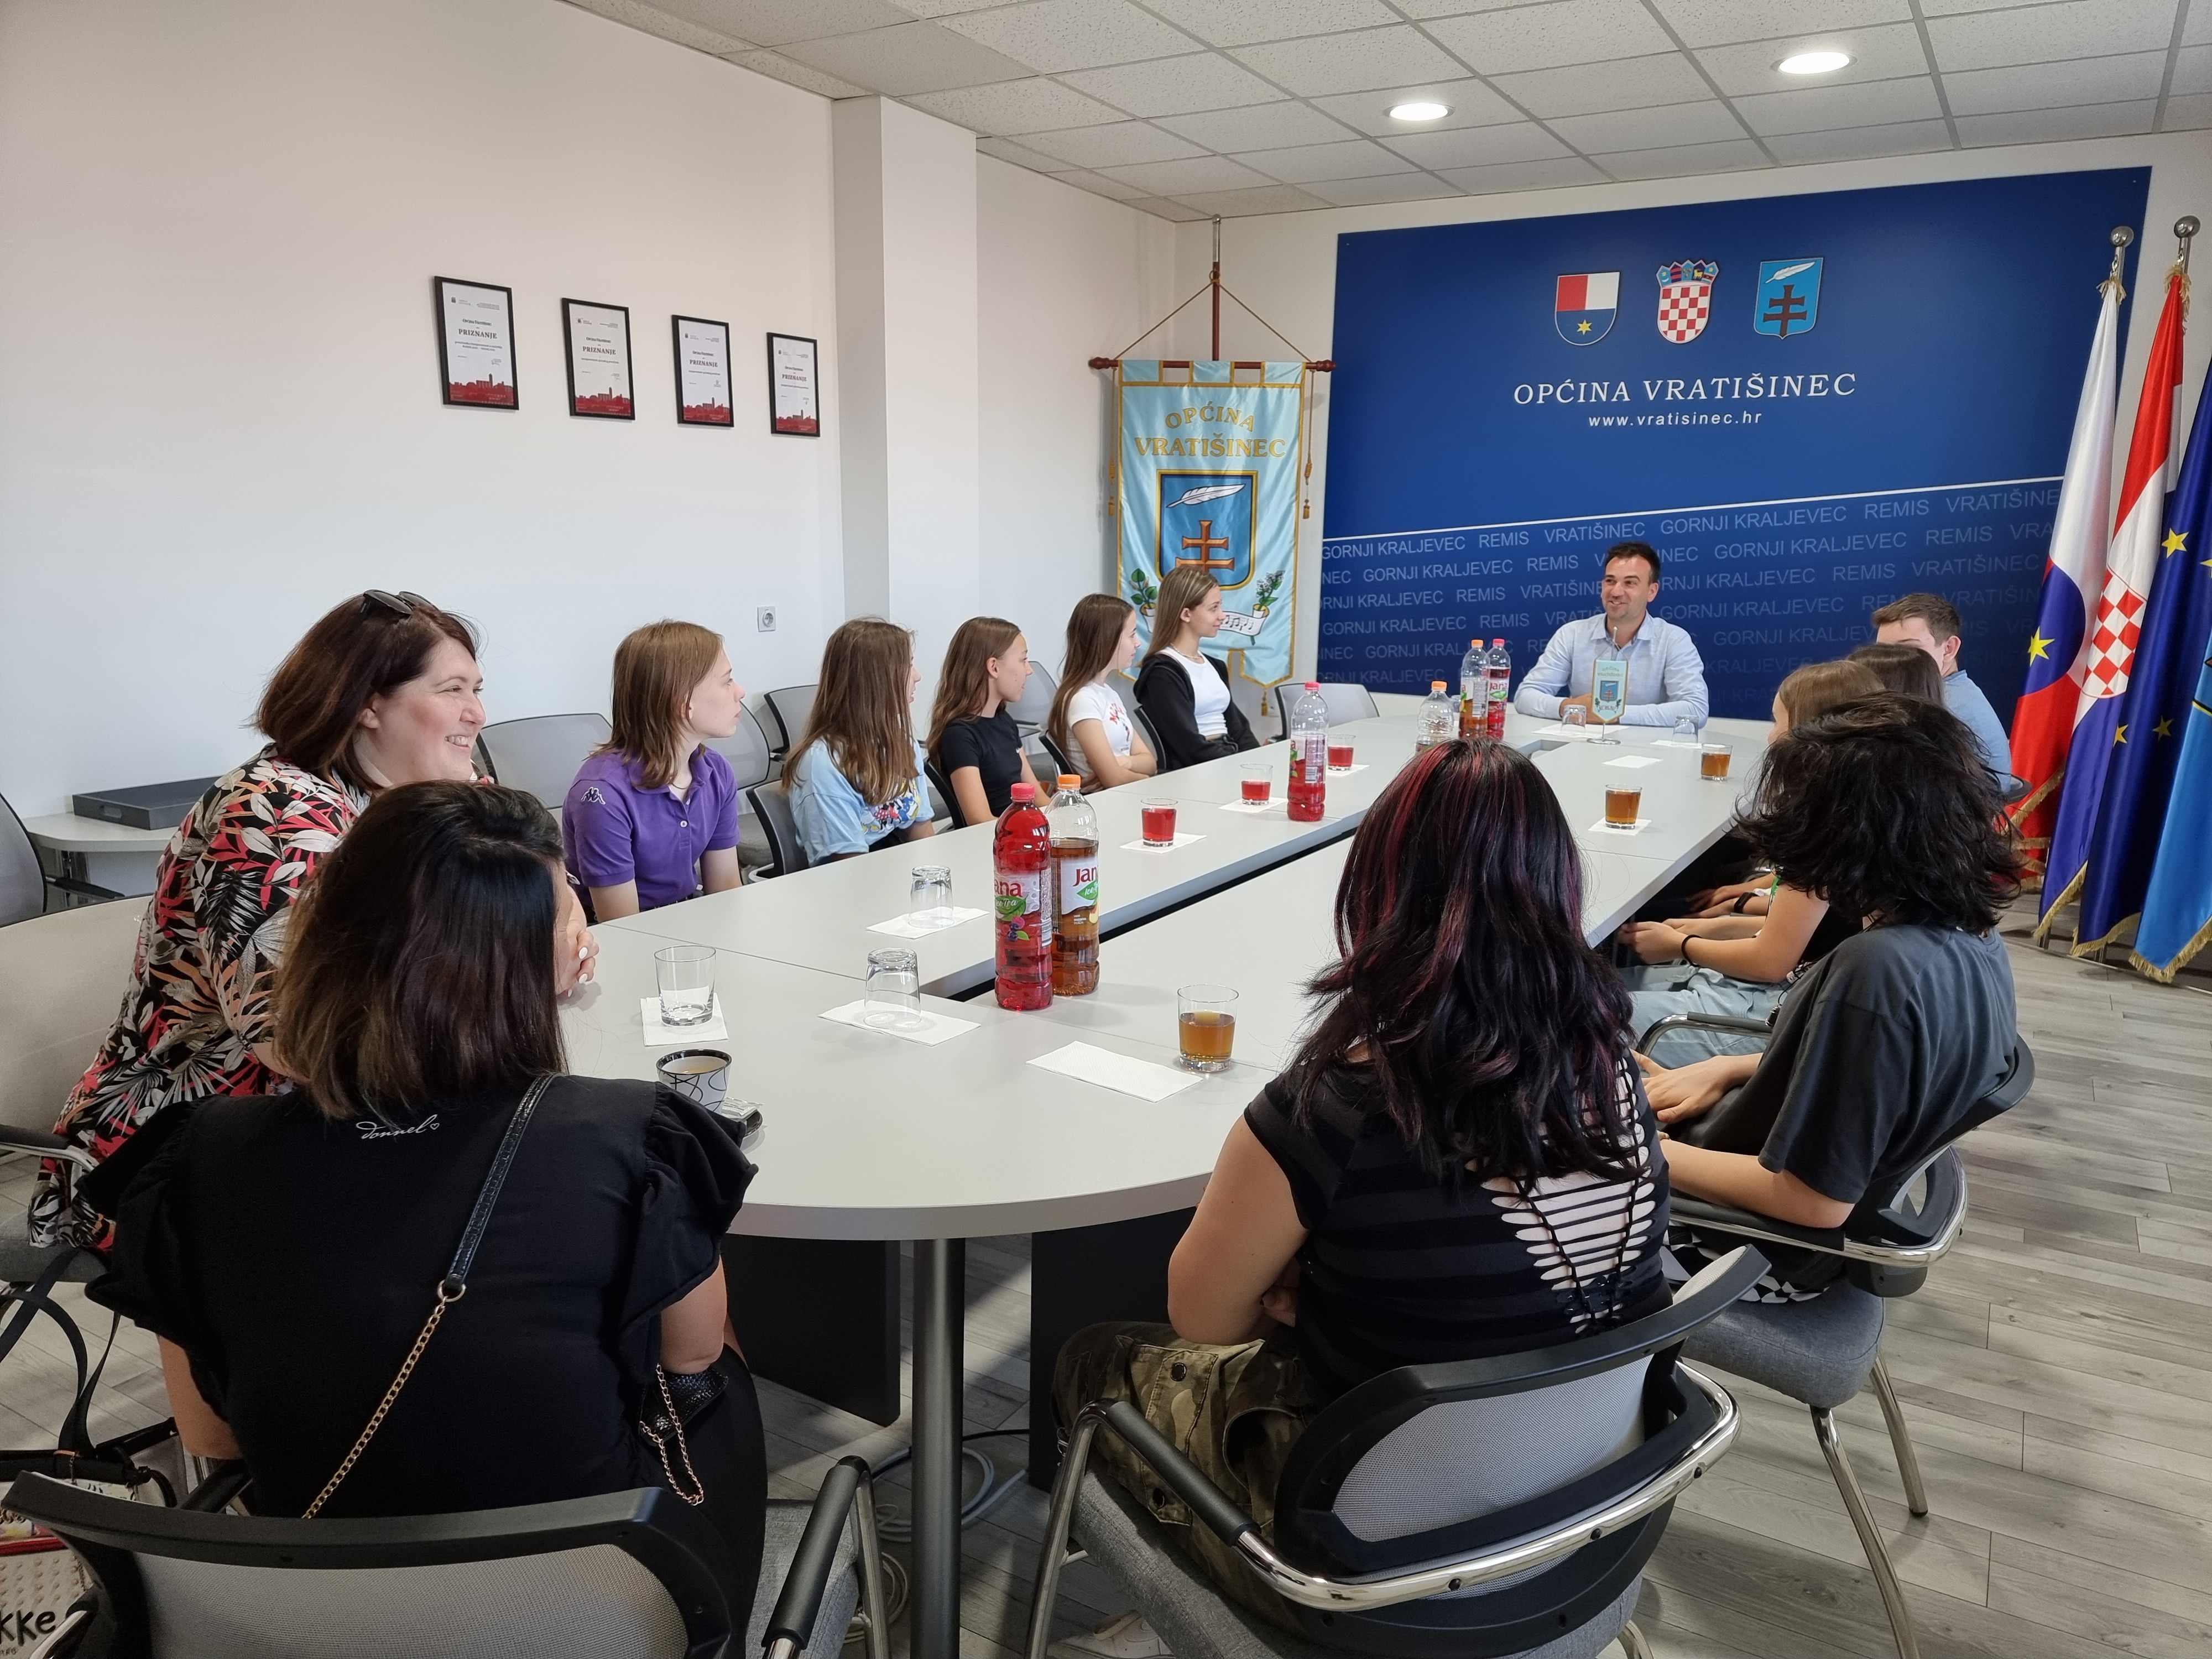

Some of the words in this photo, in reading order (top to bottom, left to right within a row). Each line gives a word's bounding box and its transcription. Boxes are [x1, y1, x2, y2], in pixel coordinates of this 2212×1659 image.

[458, 328, 497, 339] PRIZNANJE
[582, 346, 616, 355] PRIZNANJE
[690, 359, 718, 368] PRIZNANJE
[1514, 378, 1630, 405] OPĆINA
[1643, 372, 1856, 400] VRATIŠINEC
[1165, 401, 1256, 432] OPĆINA
[1589, 410, 1762, 427] www.vratisinec.hr
[1134, 433, 1286, 458] VRATIŠINEC
[1322, 544, 1374, 560] GORNJI
[1378, 536, 1466, 555] KRALJEVEC
[1479, 531, 1530, 549] REMIS
[1545, 521, 1646, 543] VRATIŠINEC
[1660, 514, 1729, 535] GORNJI
[1734, 505, 1848, 529] KRALJEVEC
[1864, 499, 1930, 520] REMIS
[1945, 488, 2060, 513] VRATIŠINE
[1363, 566, 1419, 582] GORNJI
[1422, 559, 1514, 578] KRALJEVEC
[1527, 554, 1579, 572] REMIS
[1714, 540, 1785, 560] GORNJI
[1791, 531, 1907, 555] KRALJEVEC
[1926, 526, 1993, 546] REMIS
[1358, 590, 1444, 609] KRALJEVEC
[1455, 586, 1506, 603] REMIS
[1706, 568, 1816, 589] KRALJEVEC
[1832, 563, 1896, 582] REMIS
[1912, 554, 2041, 577] VRATIŠINEC
[1323, 620, 1376, 636] GORNJI
[1380, 615, 1467, 633] KRALJEVEC
[1480, 613, 1530, 629] REMIS
[1660, 602, 1727, 620] GORNJI
[1734, 597, 1845, 617] KRALJEVEC
[1365, 643, 1420, 660] GORNJI
[1714, 629, 1782, 646] GORNJI
[1360, 668, 1446, 684] KRALJEVEC
[994, 878, 1023, 897] ana
[1072, 865, 1098, 887] Jan
[1003, 898, 1018, 907] Tea
